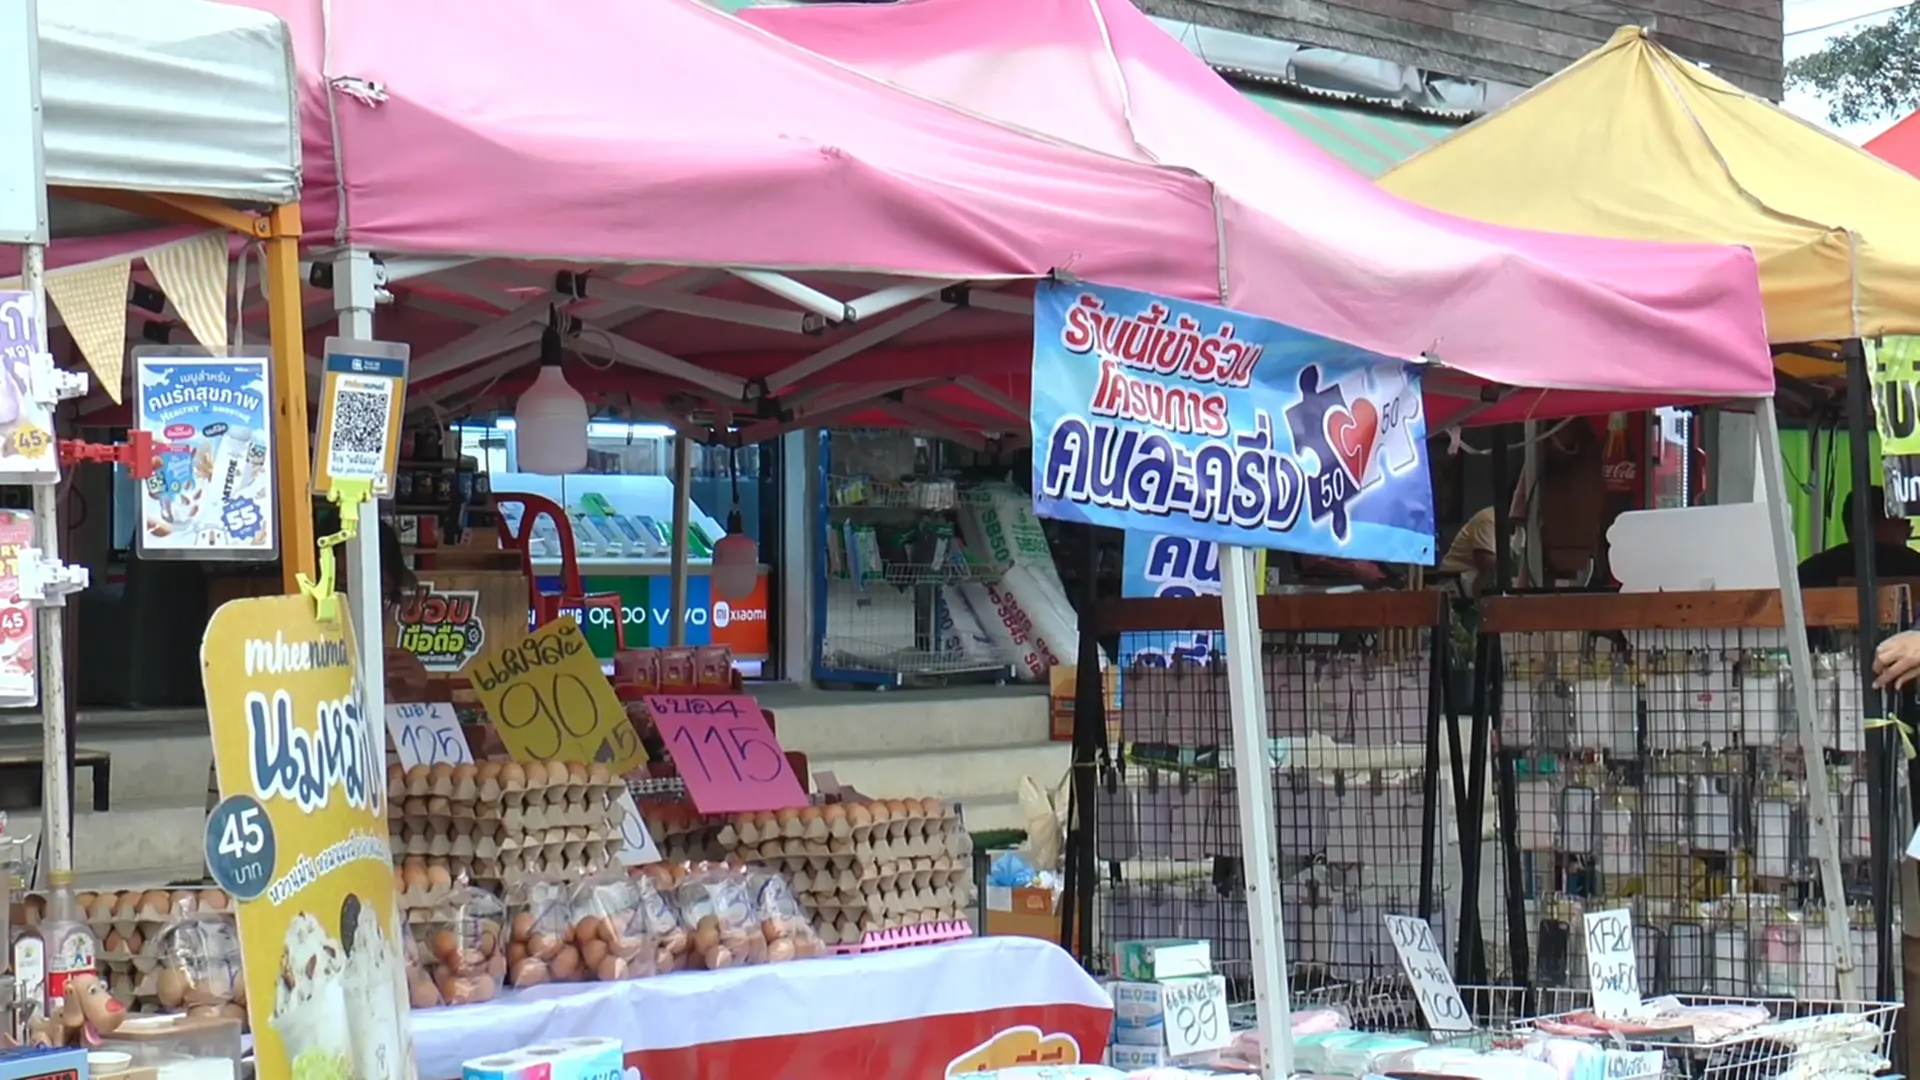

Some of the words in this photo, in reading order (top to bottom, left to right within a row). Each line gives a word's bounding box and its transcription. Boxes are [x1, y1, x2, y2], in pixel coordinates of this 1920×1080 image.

[1061, 293, 1262, 388] ร้านนี้เข้าร่วม
[179, 369, 232, 386] เมนูสำหรับ
[148, 383, 259, 413] คนรักสุขภาพ
[160, 405, 201, 423] HEALTHY
[1089, 362, 1230, 438] โครงการ
[1380, 396, 1400, 434] 50
[18, 430, 43, 448] 45
[1042, 412, 1303, 530] คนละครึ่ง
[1320, 466, 1346, 509] 50
[226, 504, 258, 532] 55
[2, 612, 24, 628] 45
[730, 609, 767, 621] xiaomi
[500, 673, 598, 759] 90
[674, 726, 781, 782] 115
[218, 807, 265, 859] 45
[233, 860, 262, 885] บาท
[1177, 999, 1218, 1047] 89
[1422, 987, 1463, 1023] 100
